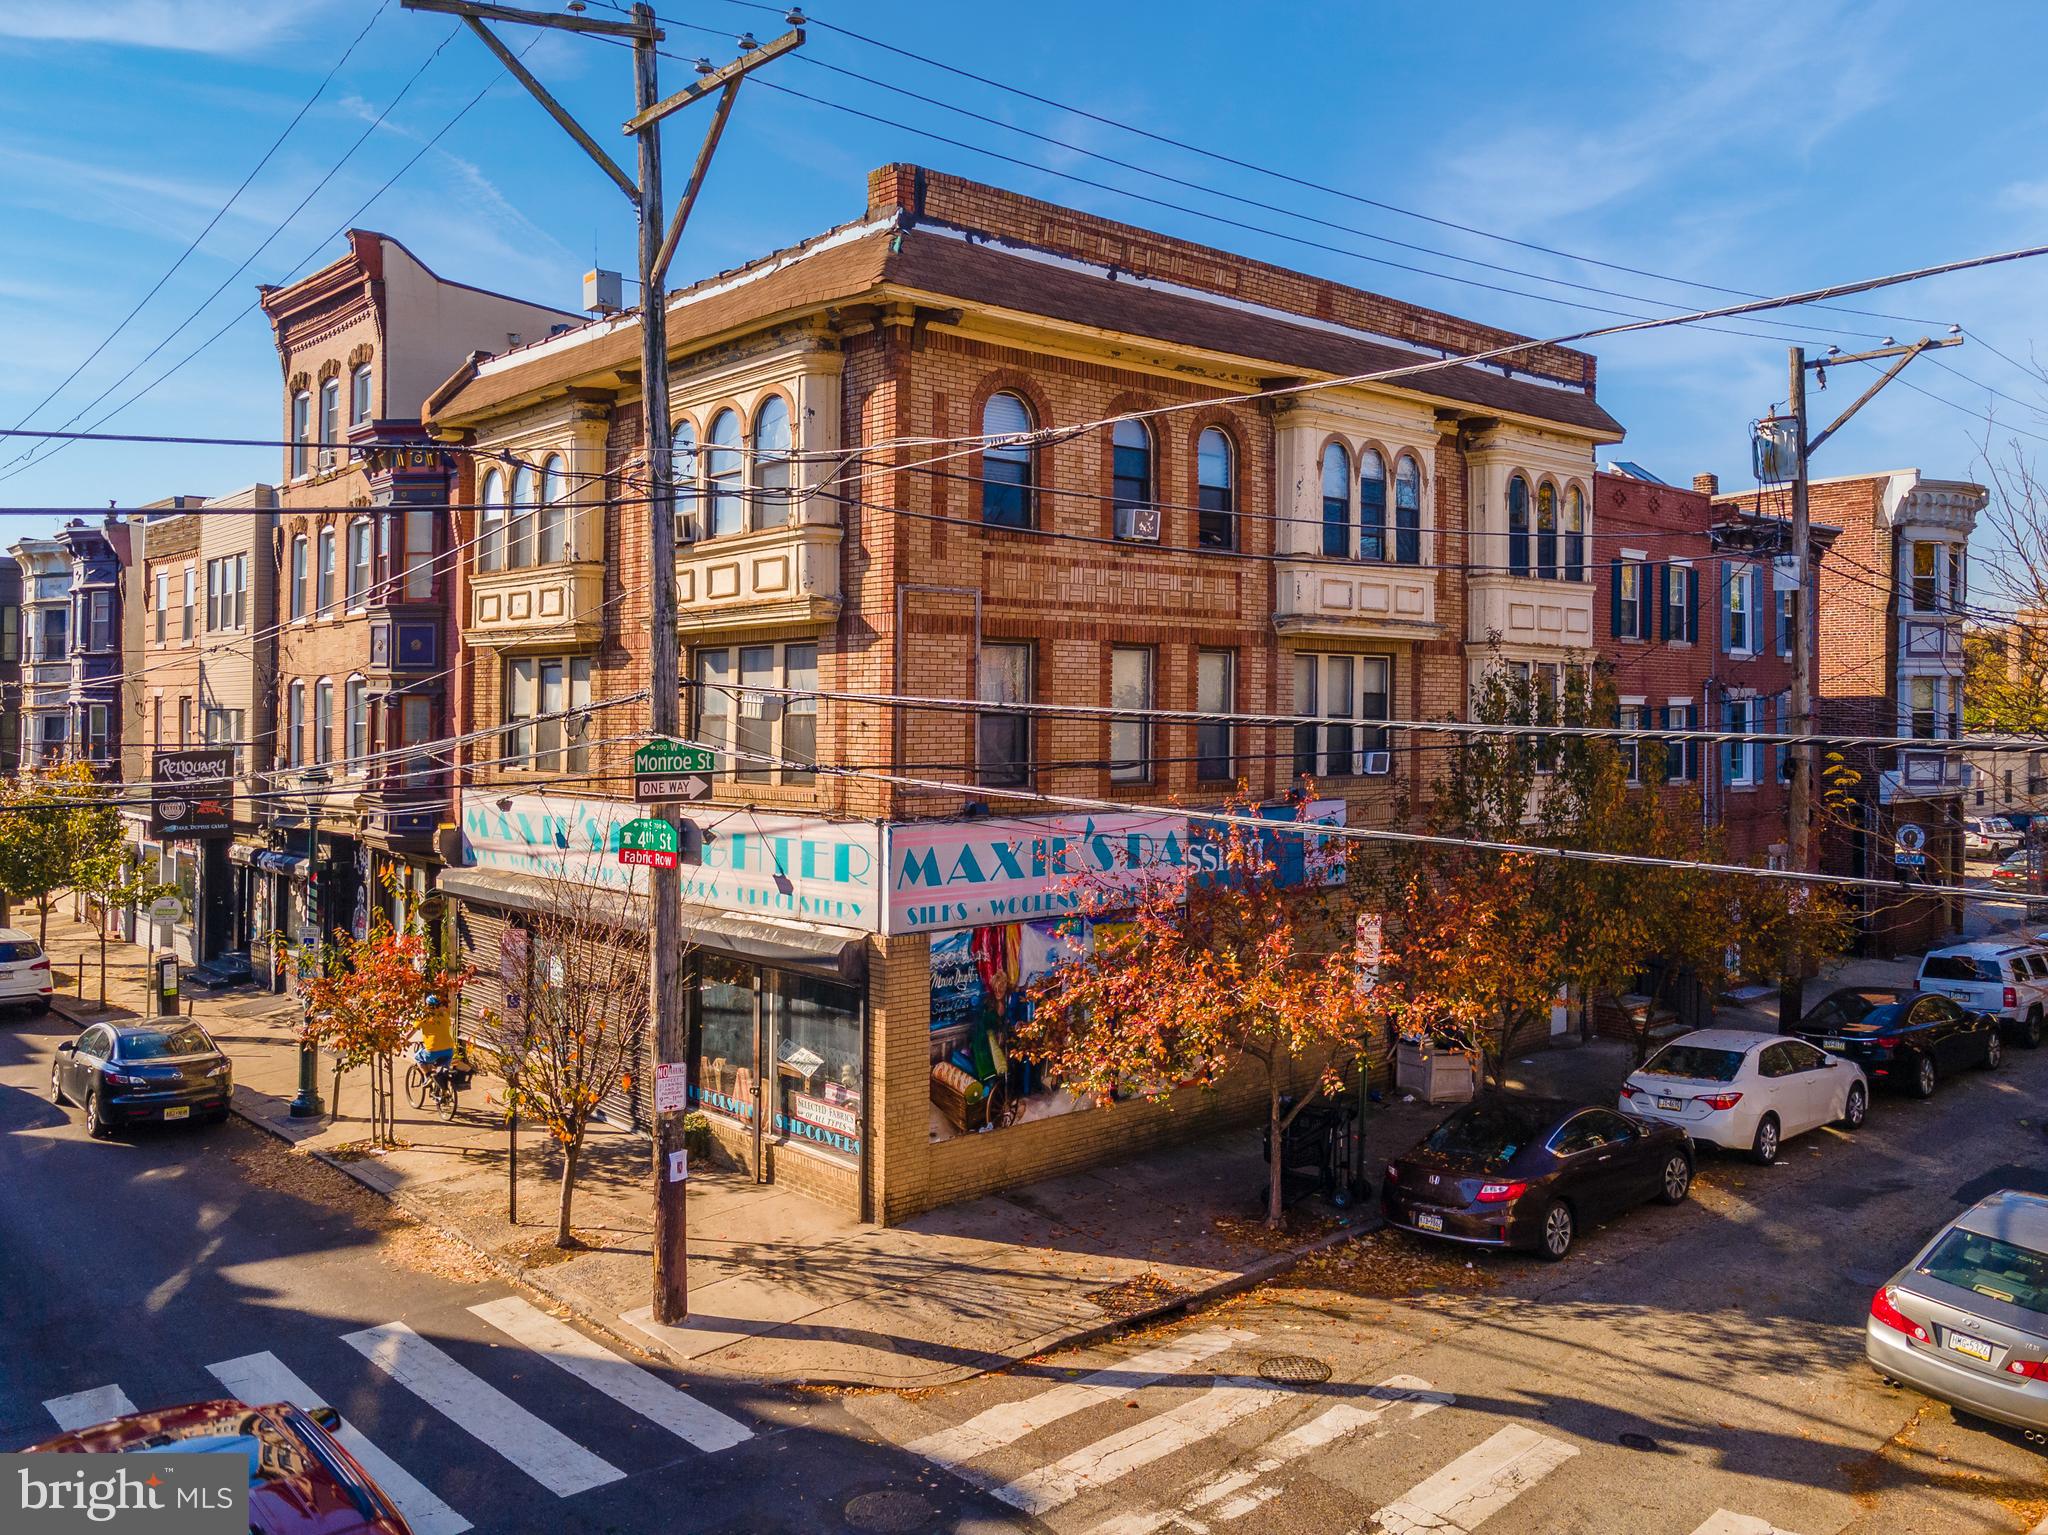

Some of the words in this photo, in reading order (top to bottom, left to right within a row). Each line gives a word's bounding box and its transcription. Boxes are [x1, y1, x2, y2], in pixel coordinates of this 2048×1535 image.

[670, 743, 678, 752] W
[637, 754, 692, 771] Monroe
[697, 753, 712, 769] St
[643, 782, 665, 794] ONE
[669, 781, 690, 793] WAY
[637, 831, 654, 848] 4th
[660, 833, 672, 850] St
[624, 851, 653, 864] Fabric
[655, 853, 672, 866] Row
[897, 816, 1114, 890] MAXIE'S
[907, 903, 969, 926] SILKS
[990, 891, 1080, 917] WOOLENS
[658, 1066, 668, 1079] NO
[798, 1098, 827, 1114] SELECTED
[830, 1108, 854, 1124] FABRICS
[816, 1114, 825, 1123] ALL
[828, 1118, 847, 1130] TYPES
[775, 1113, 860, 1155] SLIPCOVERS
[1952, 1333, 1989, 1356] HMG-5326
